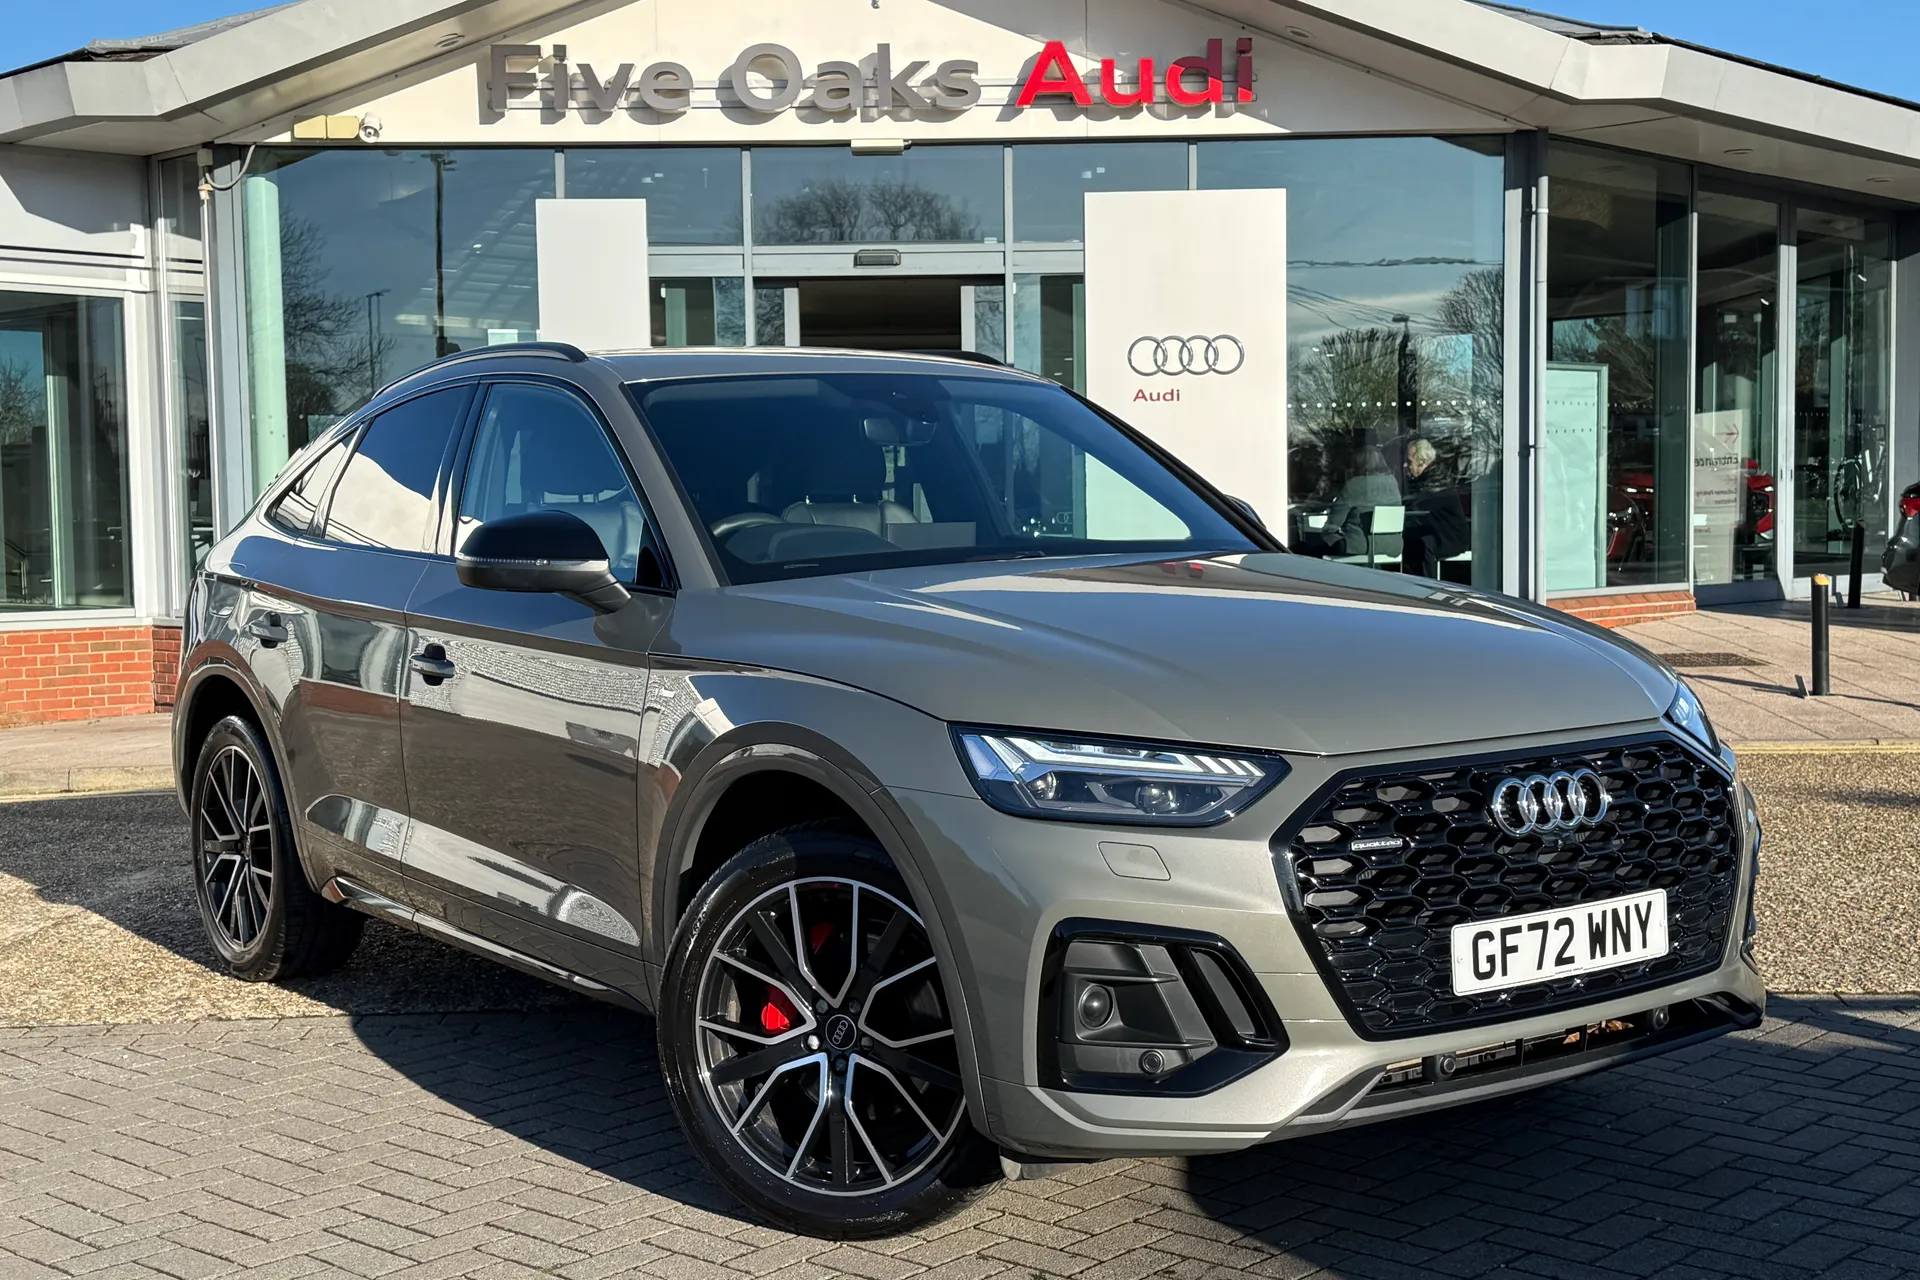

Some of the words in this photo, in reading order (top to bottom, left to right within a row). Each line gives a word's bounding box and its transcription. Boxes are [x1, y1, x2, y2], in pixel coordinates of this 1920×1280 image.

[490, 44, 693, 111] Five
[732, 43, 981, 111] Oaks
[1015, 38, 1252, 106] Audi
[1133, 388, 1180, 402] Audi
[1354, 840, 1400, 849] quattro
[1472, 917, 1575, 981] GF72
[1587, 901, 1652, 960] WNY
